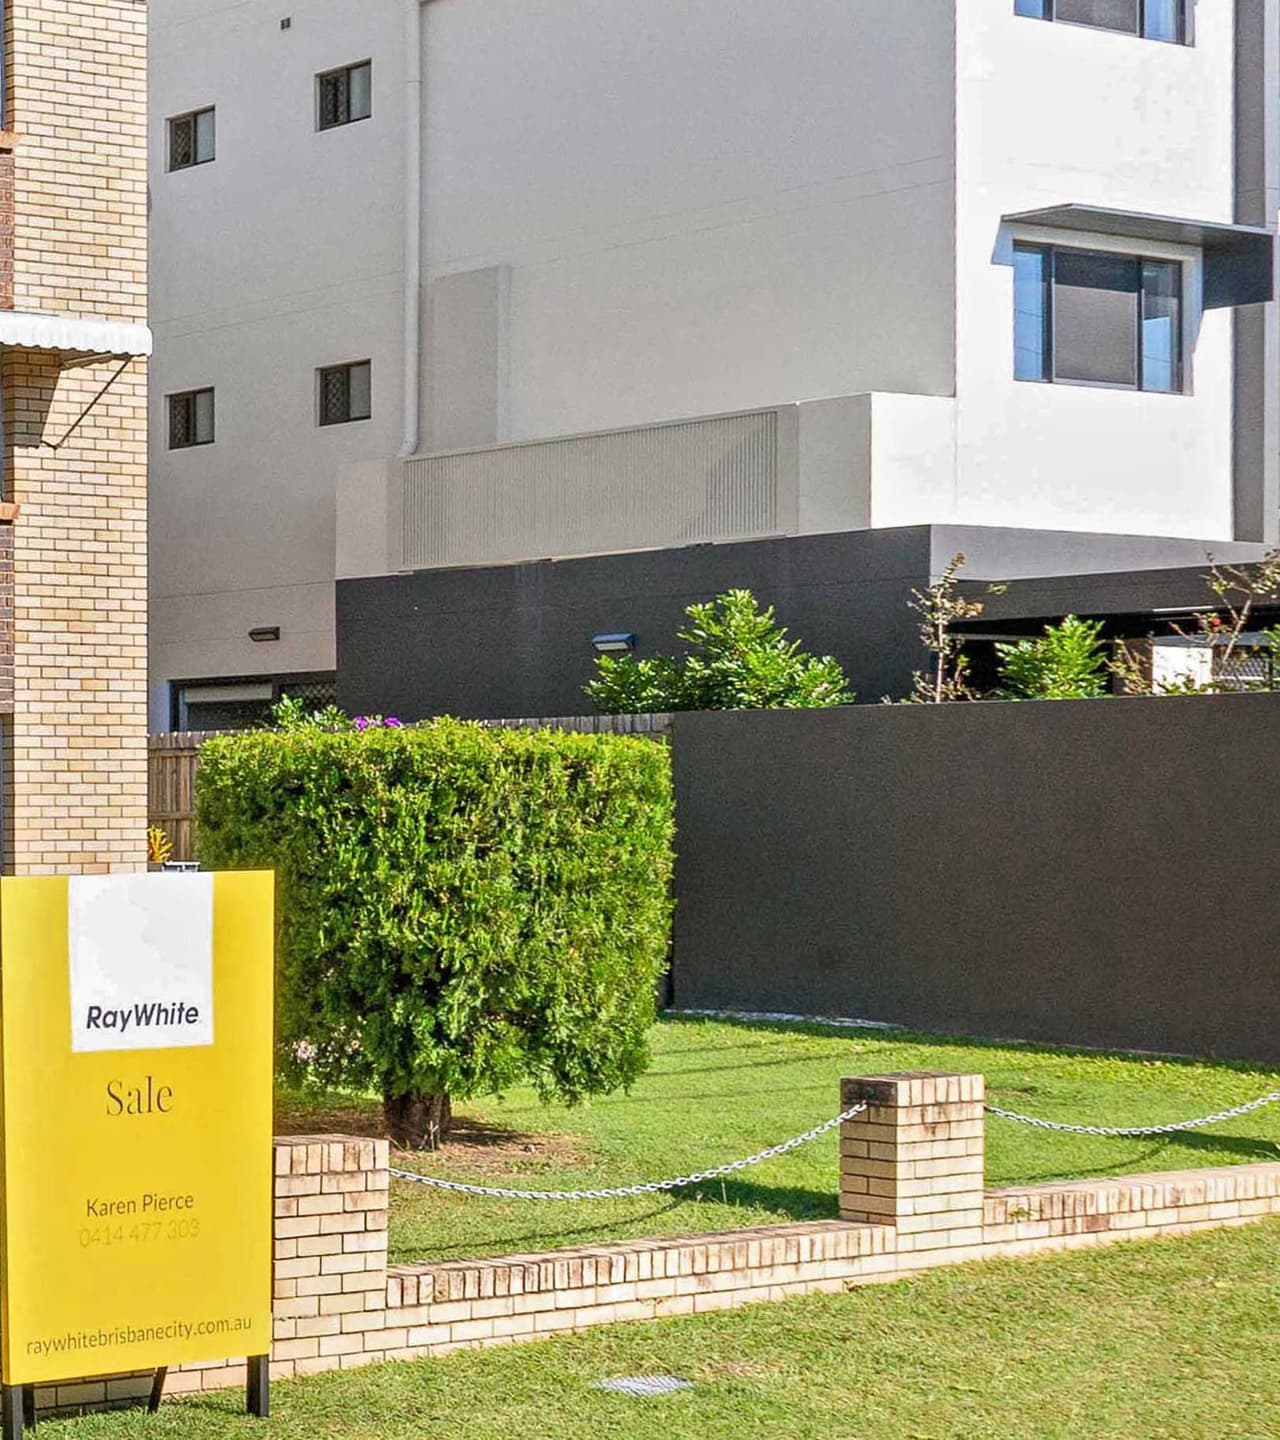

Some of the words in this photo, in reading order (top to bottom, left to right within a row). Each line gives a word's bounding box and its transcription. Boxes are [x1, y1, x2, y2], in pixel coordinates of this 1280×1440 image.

[106, 1075, 173, 1117] Sale
[86, 1198, 137, 1217] Karen
[142, 1193, 195, 1213] Pierce
[79, 1224, 124, 1248] 0414
[128, 1221, 163, 1242] 477
[167, 1218, 200, 1240] 303
[26, 1316, 253, 1357] raywhitebrisbanecity.com.au
